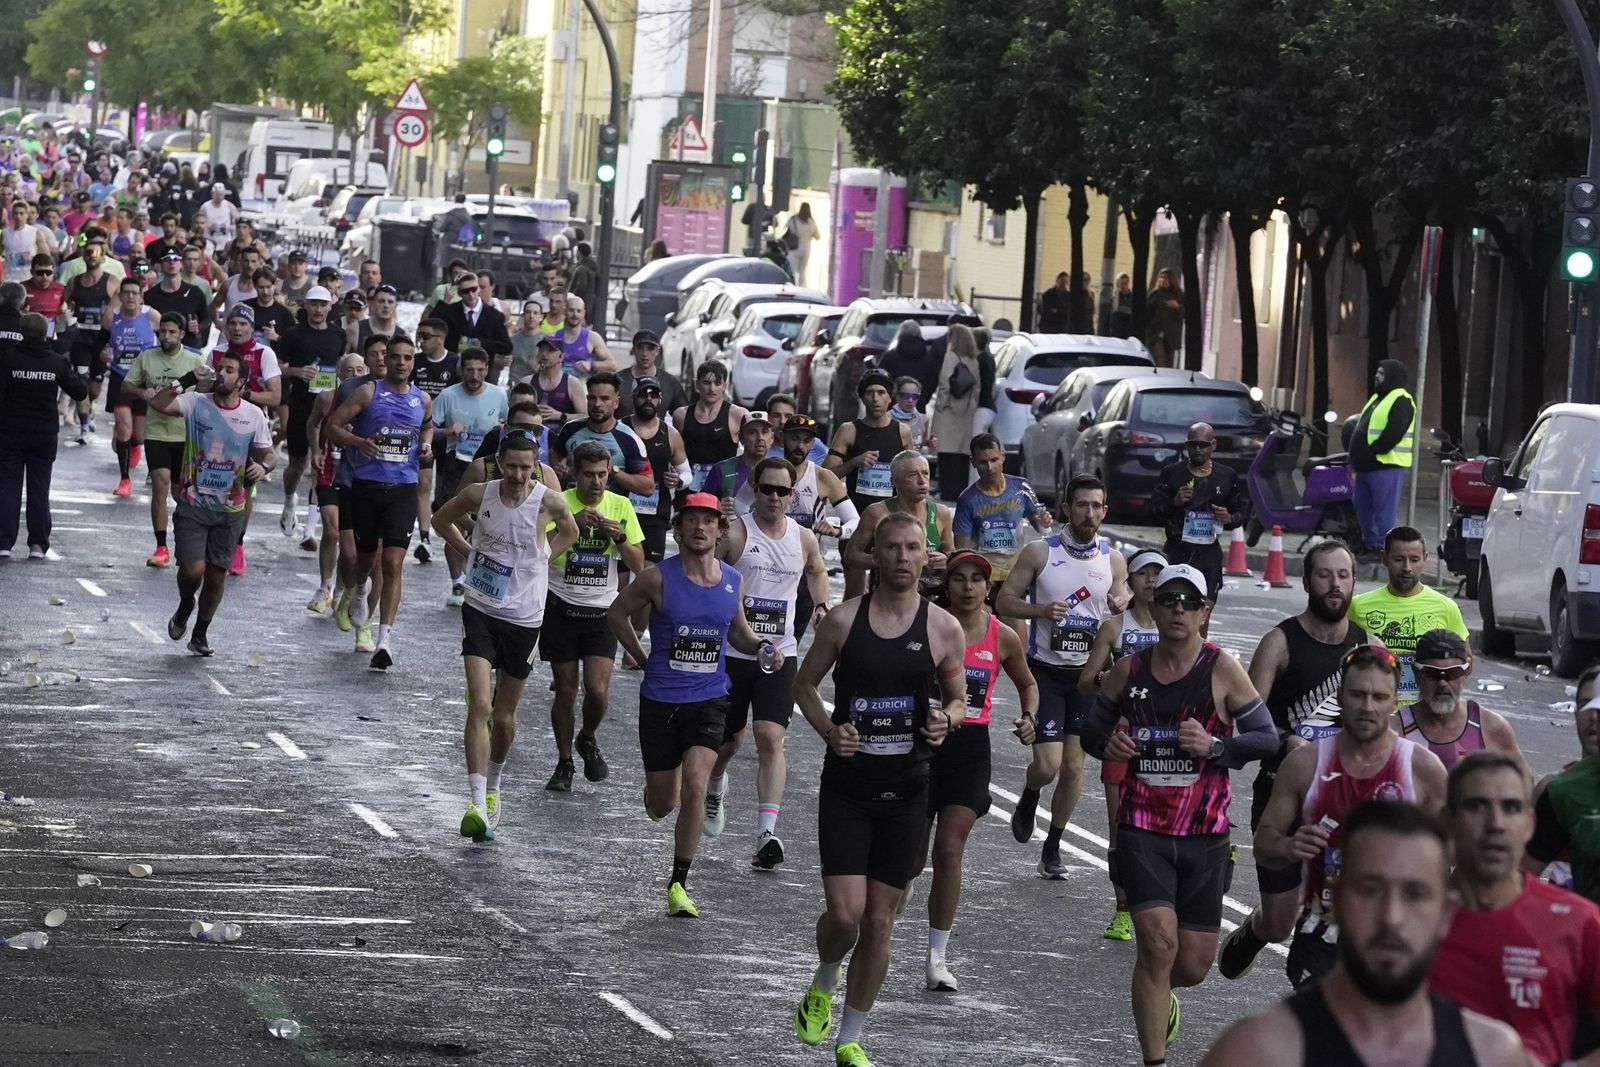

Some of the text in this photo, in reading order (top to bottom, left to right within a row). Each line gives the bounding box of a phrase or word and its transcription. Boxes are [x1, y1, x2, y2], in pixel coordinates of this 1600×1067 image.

[401, 123, 421, 136] 30
[12, 370, 56, 381] VOLUNTEER
[581, 555, 606, 563] ZURICH
[486, 559, 509, 574] ZURICH
[565, 575, 608, 586] JAVIERDEBE
[470, 576, 501, 597] SERTOLI
[756, 599, 783, 609] ZURICH
[755, 612, 770, 621] 3857
[691, 628, 719, 636] ZURICH
[1068, 631, 1084, 640] 4475
[690, 642, 707, 650] 3794
[1061, 640, 1089, 651] PERDI
[674, 649, 718, 662] CHARLOT
[871, 700, 907, 710] ZURICH
[871, 718, 892, 727] 4542
[1155, 747, 1175, 757] 5041
[1139, 759, 1194, 772] IRONDOC
